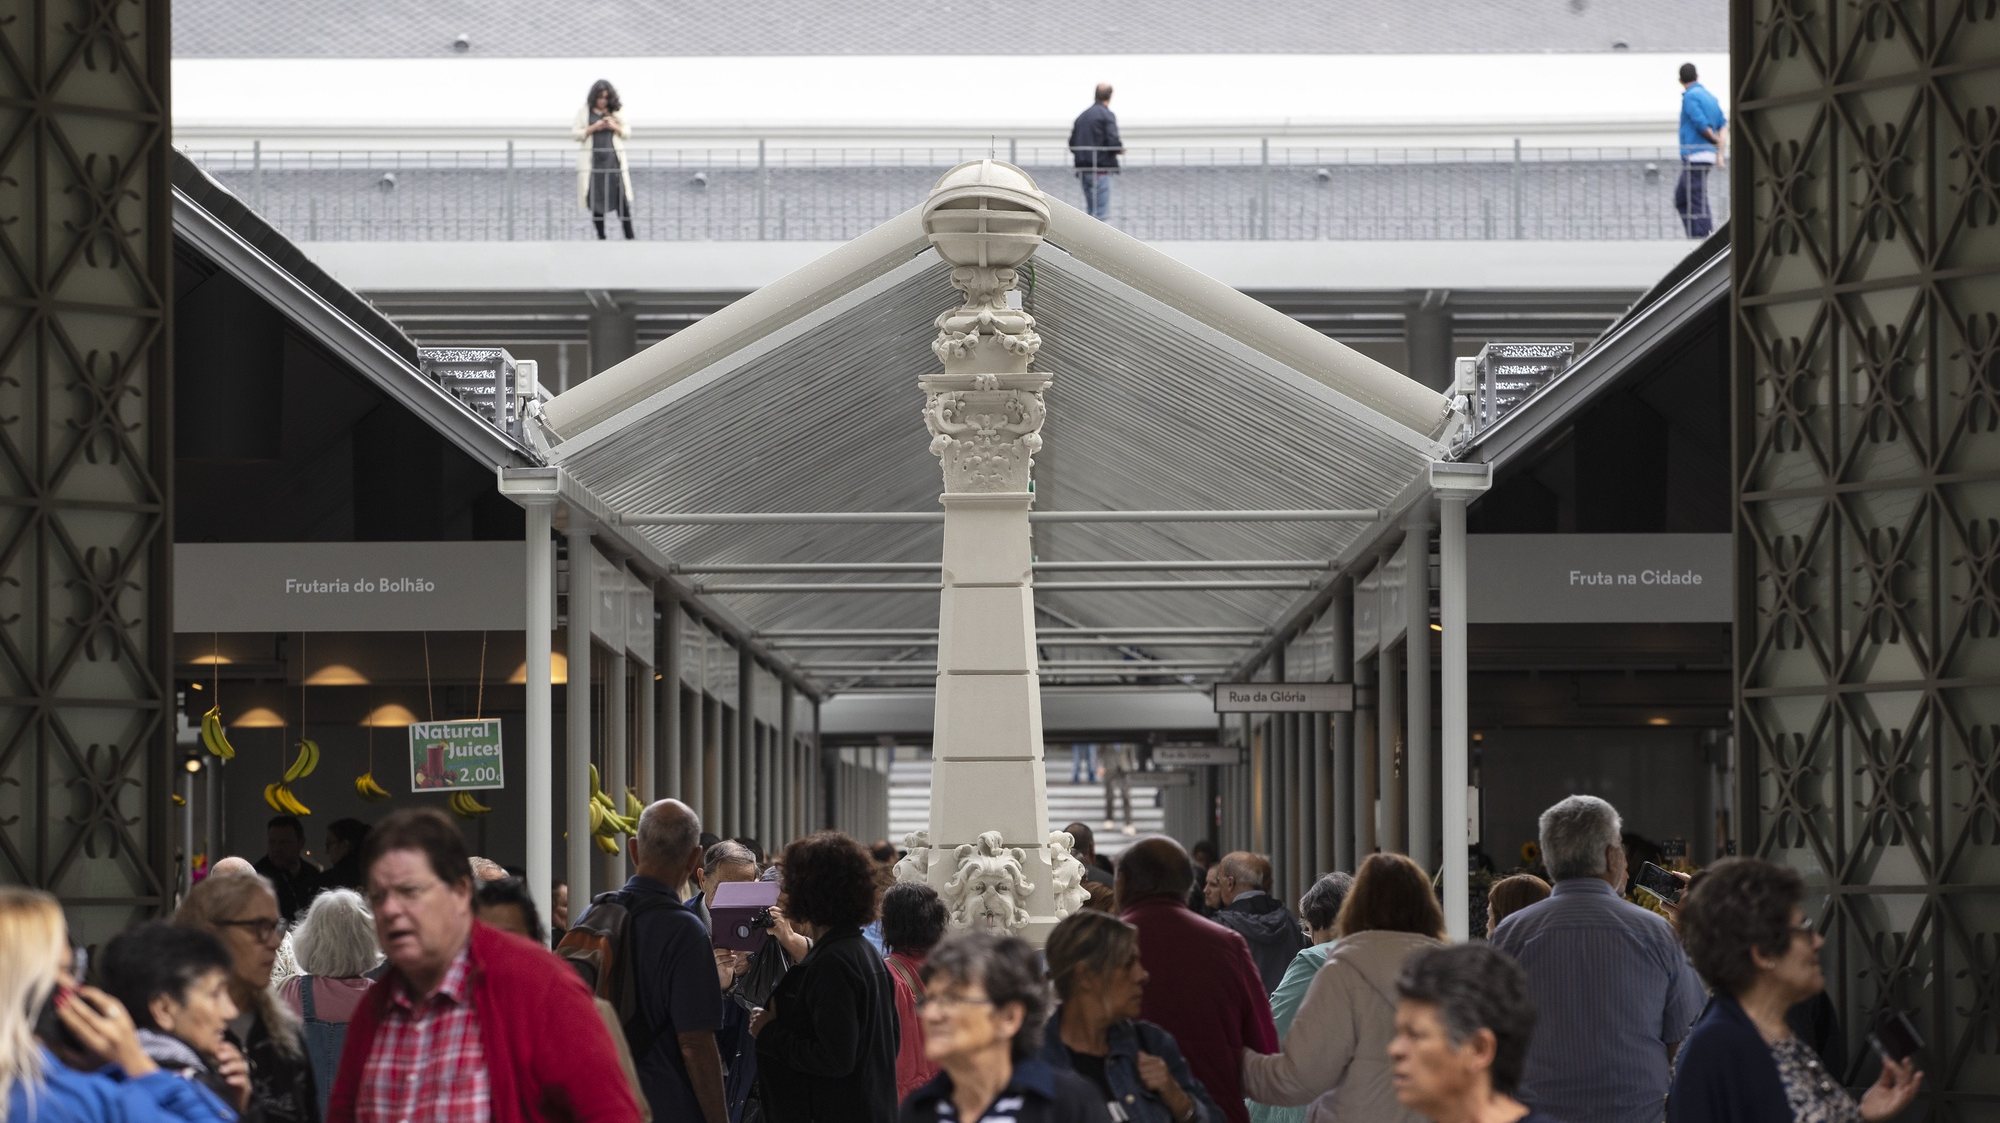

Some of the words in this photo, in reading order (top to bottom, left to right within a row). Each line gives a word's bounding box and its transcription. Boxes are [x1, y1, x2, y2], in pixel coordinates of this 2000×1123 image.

[1570, 570, 1613, 585] Fruta
[1617, 574, 1637, 585] na
[1640, 570, 1703, 585] Cidade
[285, 578, 350, 594] Frutaria
[353, 578, 375, 593] do
[379, 578, 435, 593] Bolhão
[1229, 691, 1251, 703] Rua
[1253, 691, 1268, 703] da
[1270, 690, 1306, 703] Glória
[414, 722, 489, 740] Natural
[448, 741, 500, 760] Juices
